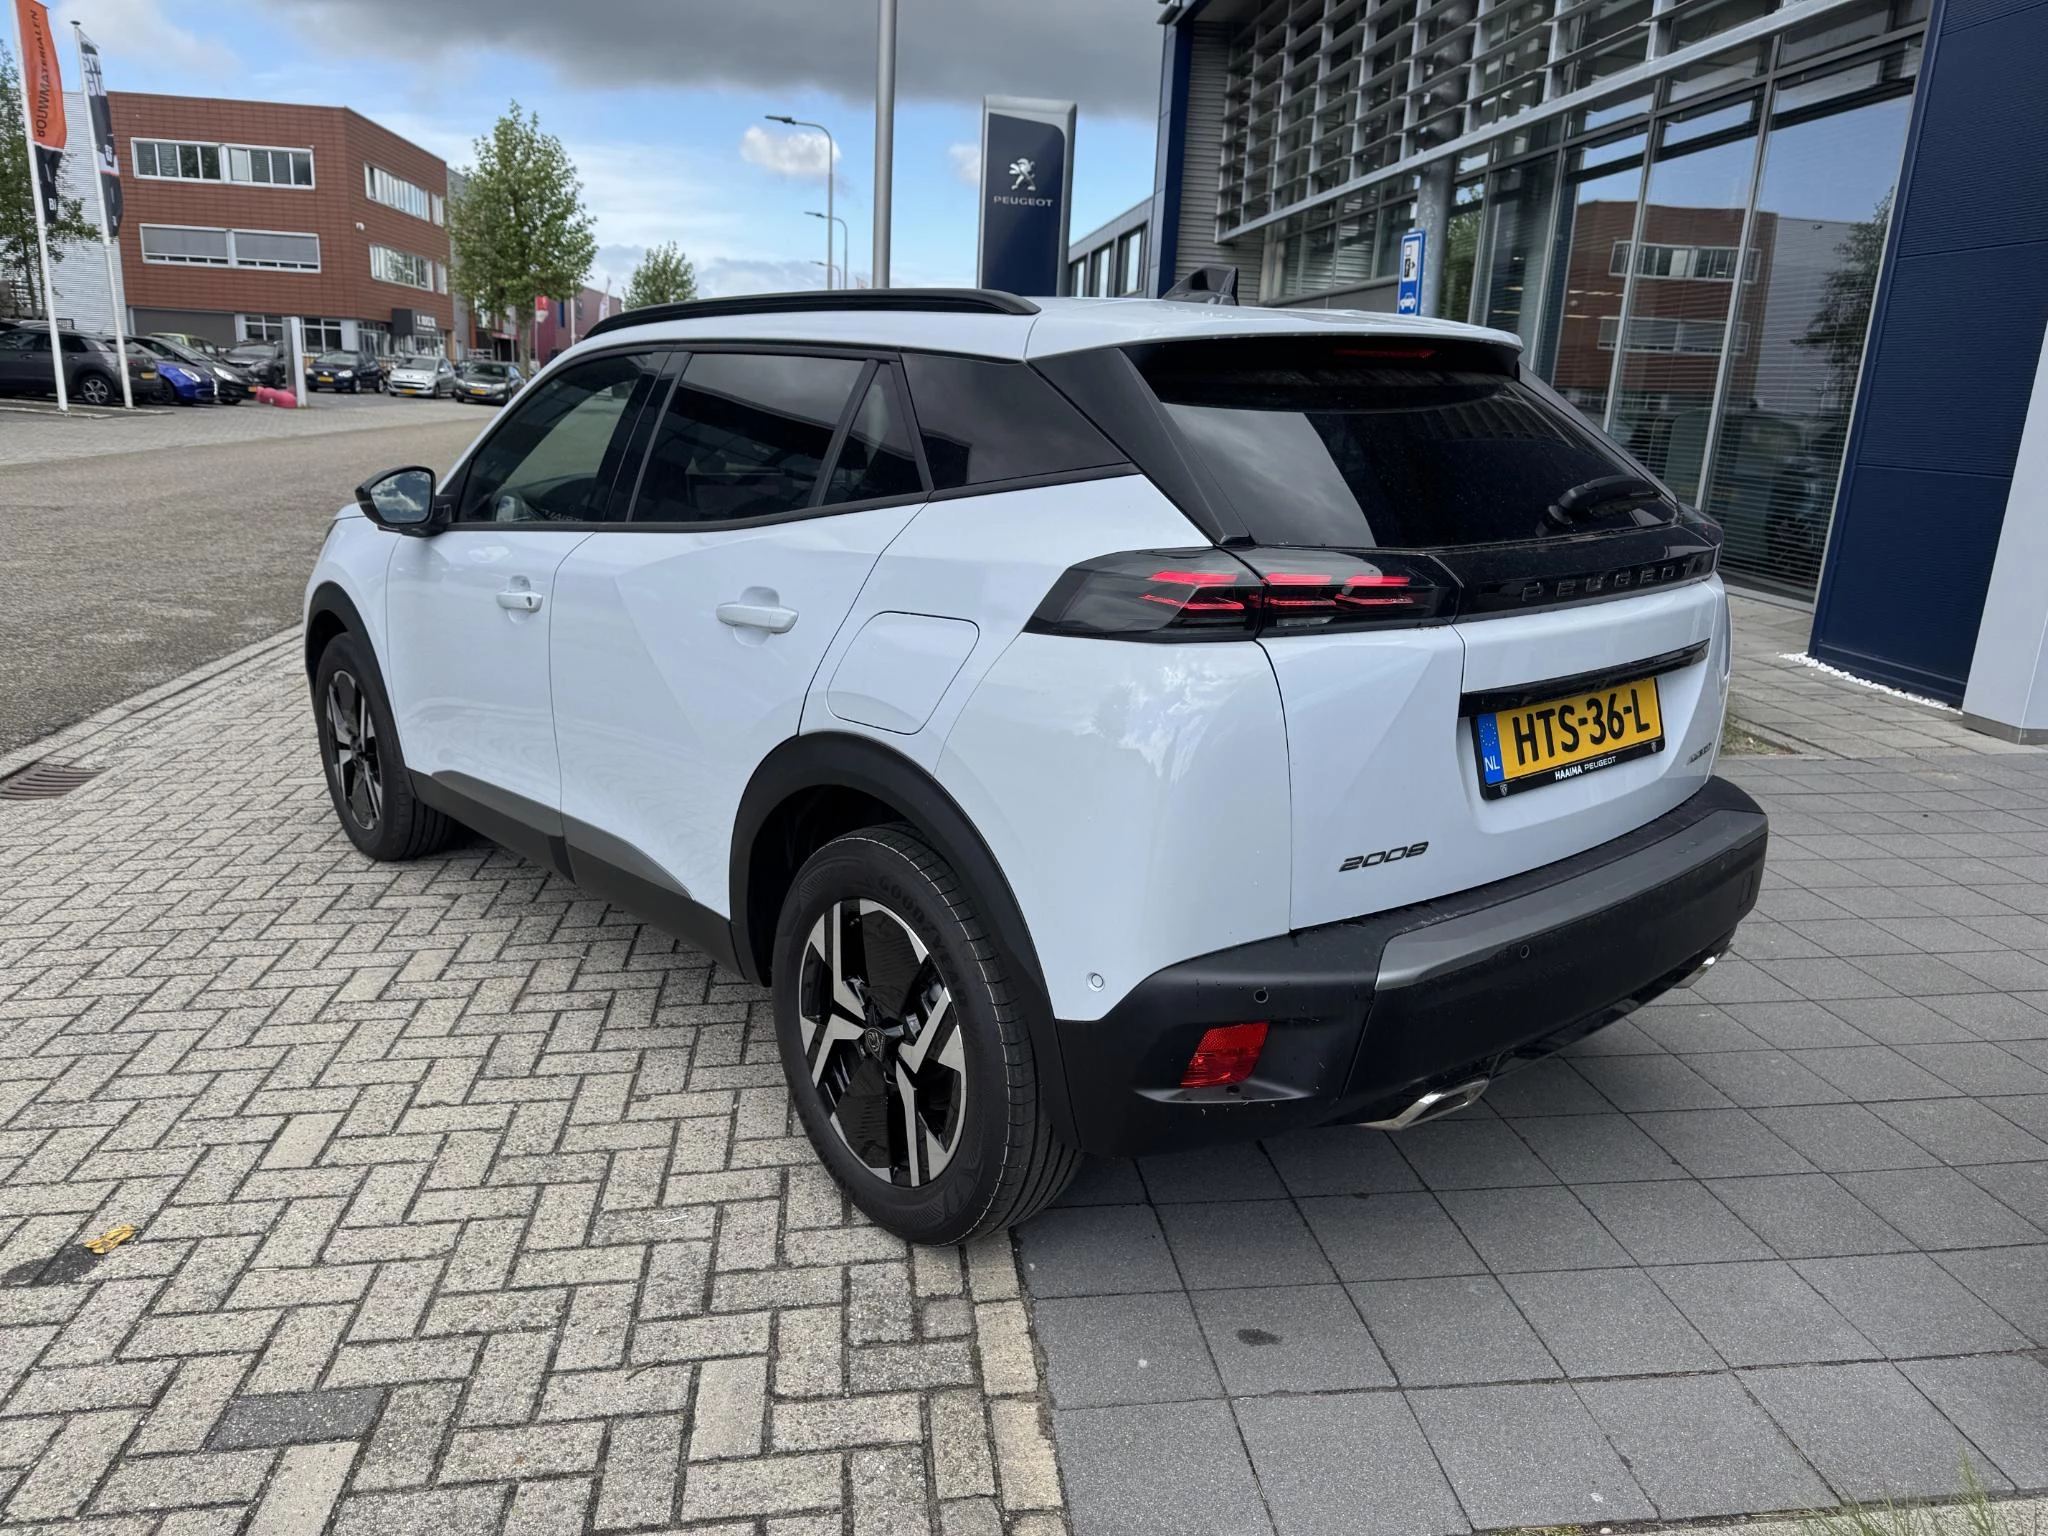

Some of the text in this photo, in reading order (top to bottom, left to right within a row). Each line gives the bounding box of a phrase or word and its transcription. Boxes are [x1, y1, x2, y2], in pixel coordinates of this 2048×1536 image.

[993, 195, 1053, 207] PEUGEOT
[1521, 555, 1697, 602] PEUGEOT
[1512, 689, 1650, 766] HTS-36-L
[1484, 756, 1501, 772] NL
[1554, 755, 1617, 781] HAAIMA PEUGEOT
[1338, 840, 1429, 872] 2008
